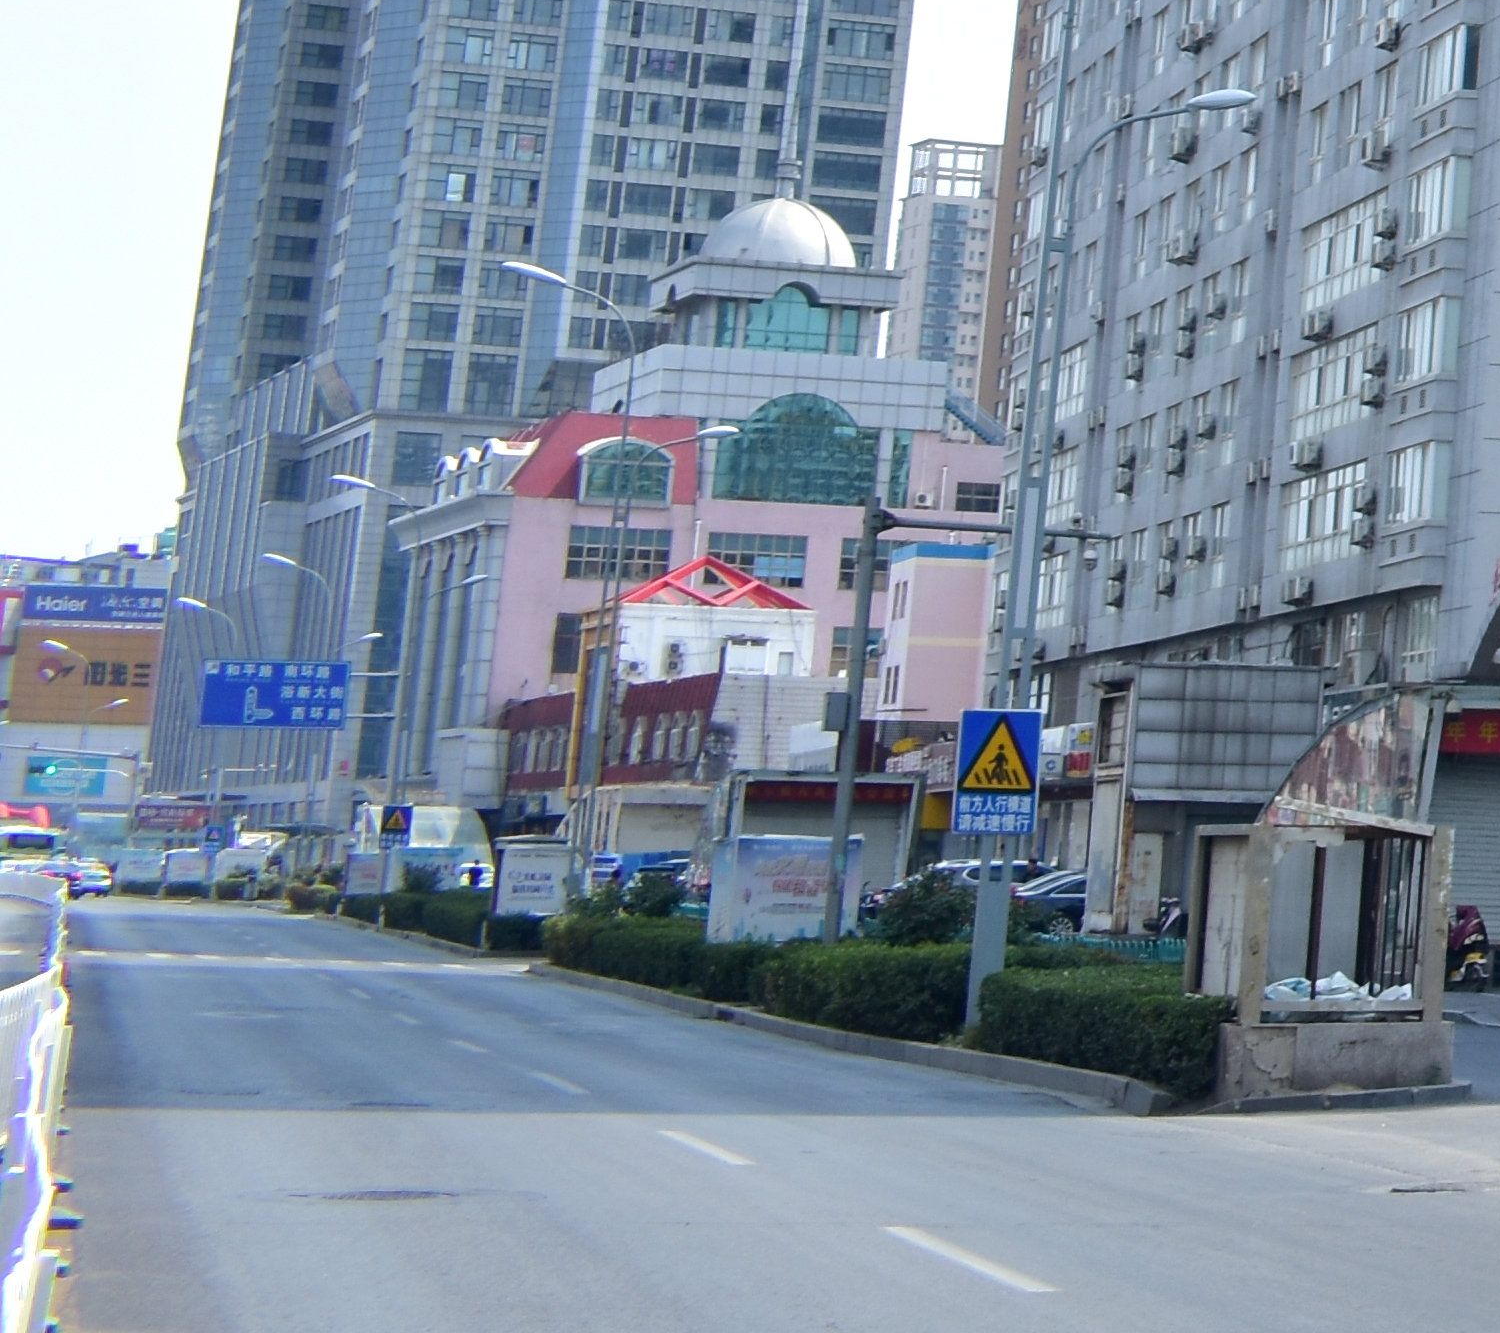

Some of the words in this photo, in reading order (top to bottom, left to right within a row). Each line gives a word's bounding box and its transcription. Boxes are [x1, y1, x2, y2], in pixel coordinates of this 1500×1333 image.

[36, 596, 87, 612] Haier
[959, 795, 1031, 813] 前方人行横道
[958, 814, 1030, 832] 请减速慢行
